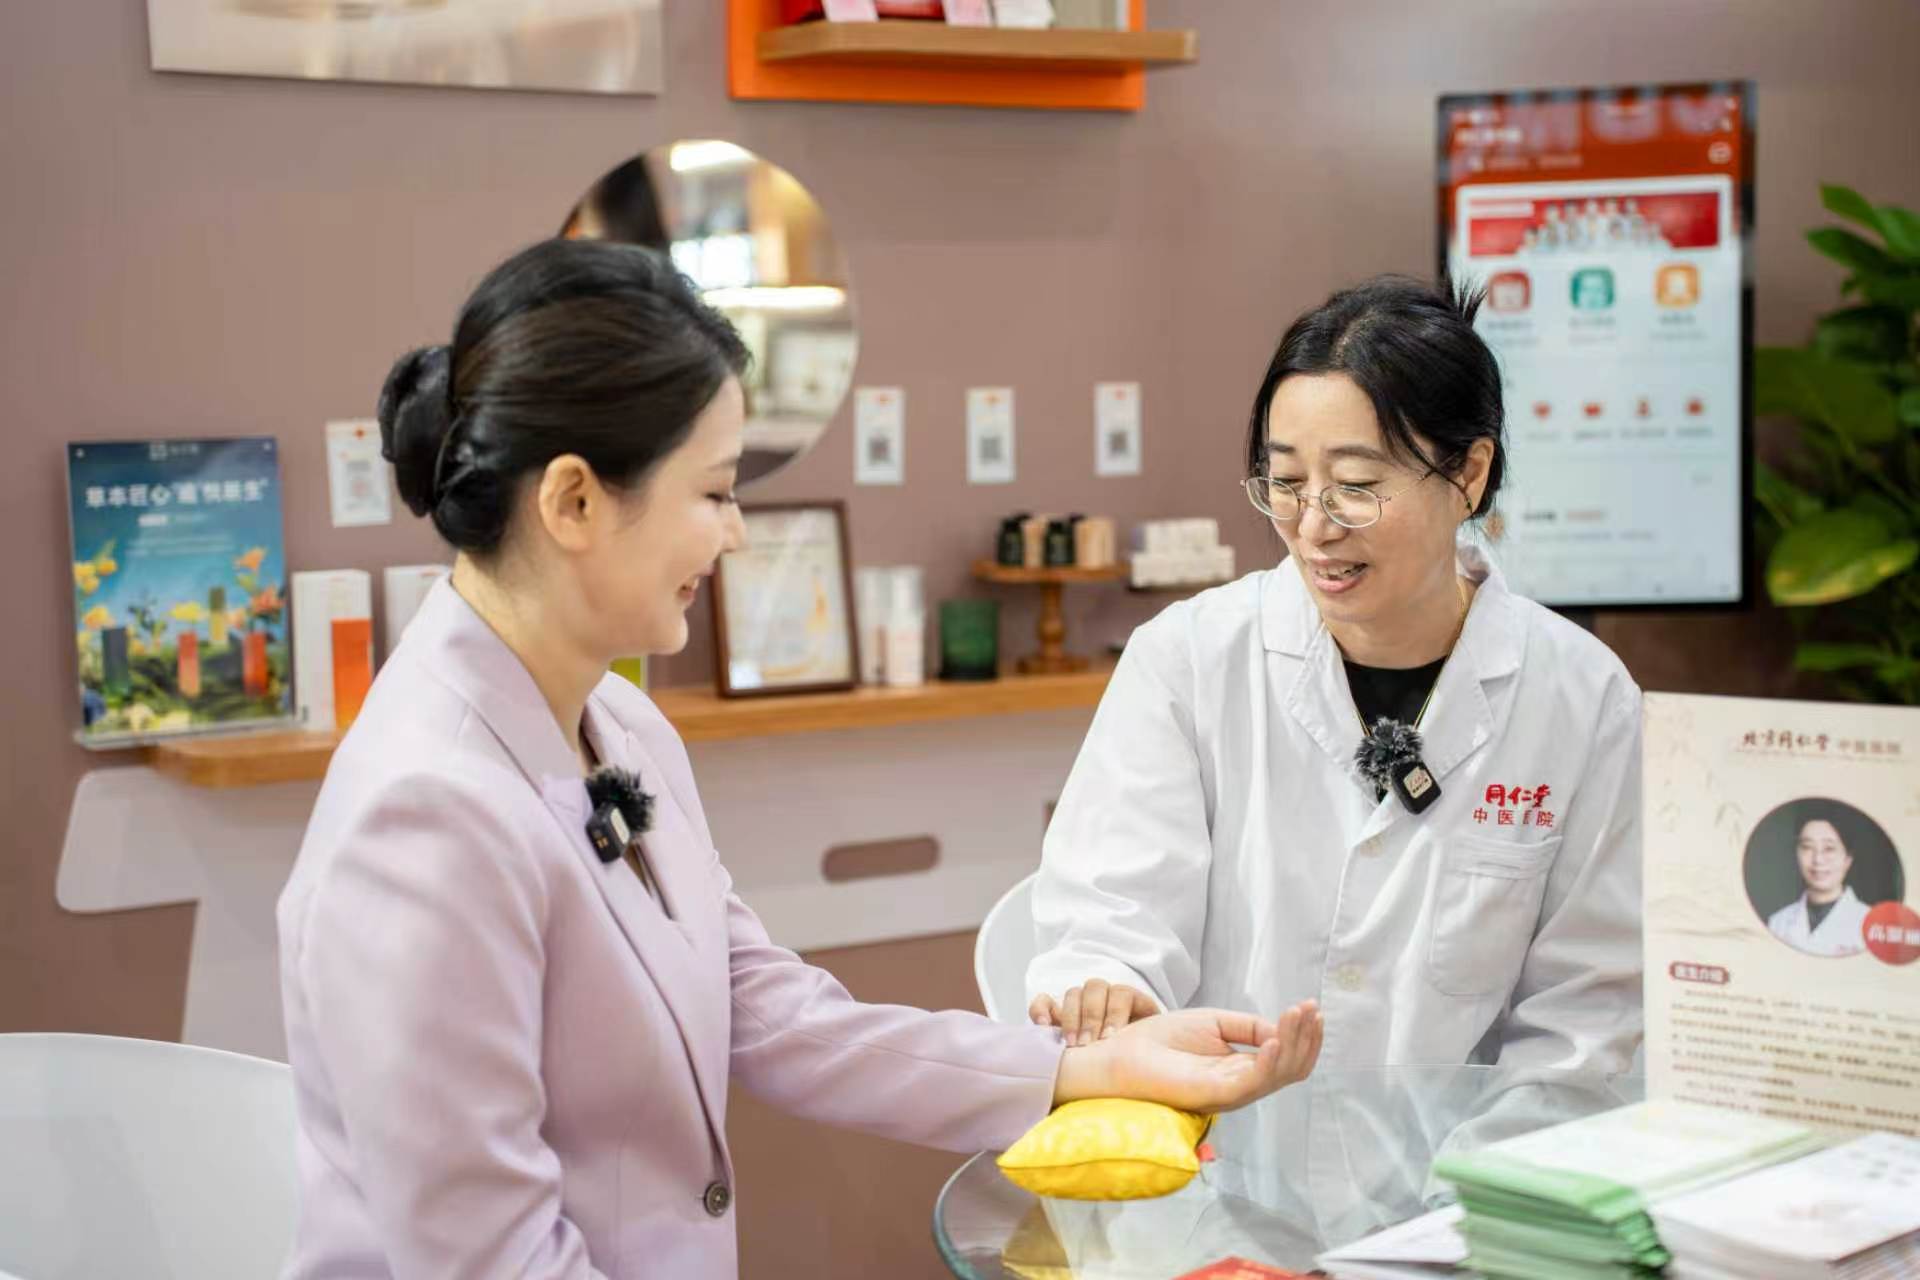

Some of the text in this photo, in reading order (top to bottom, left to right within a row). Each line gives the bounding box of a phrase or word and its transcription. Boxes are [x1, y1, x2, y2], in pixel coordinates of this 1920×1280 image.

[1743, 729, 1829, 752] 北京同仁堂
[1485, 783, 1551, 808] 同仁堂
